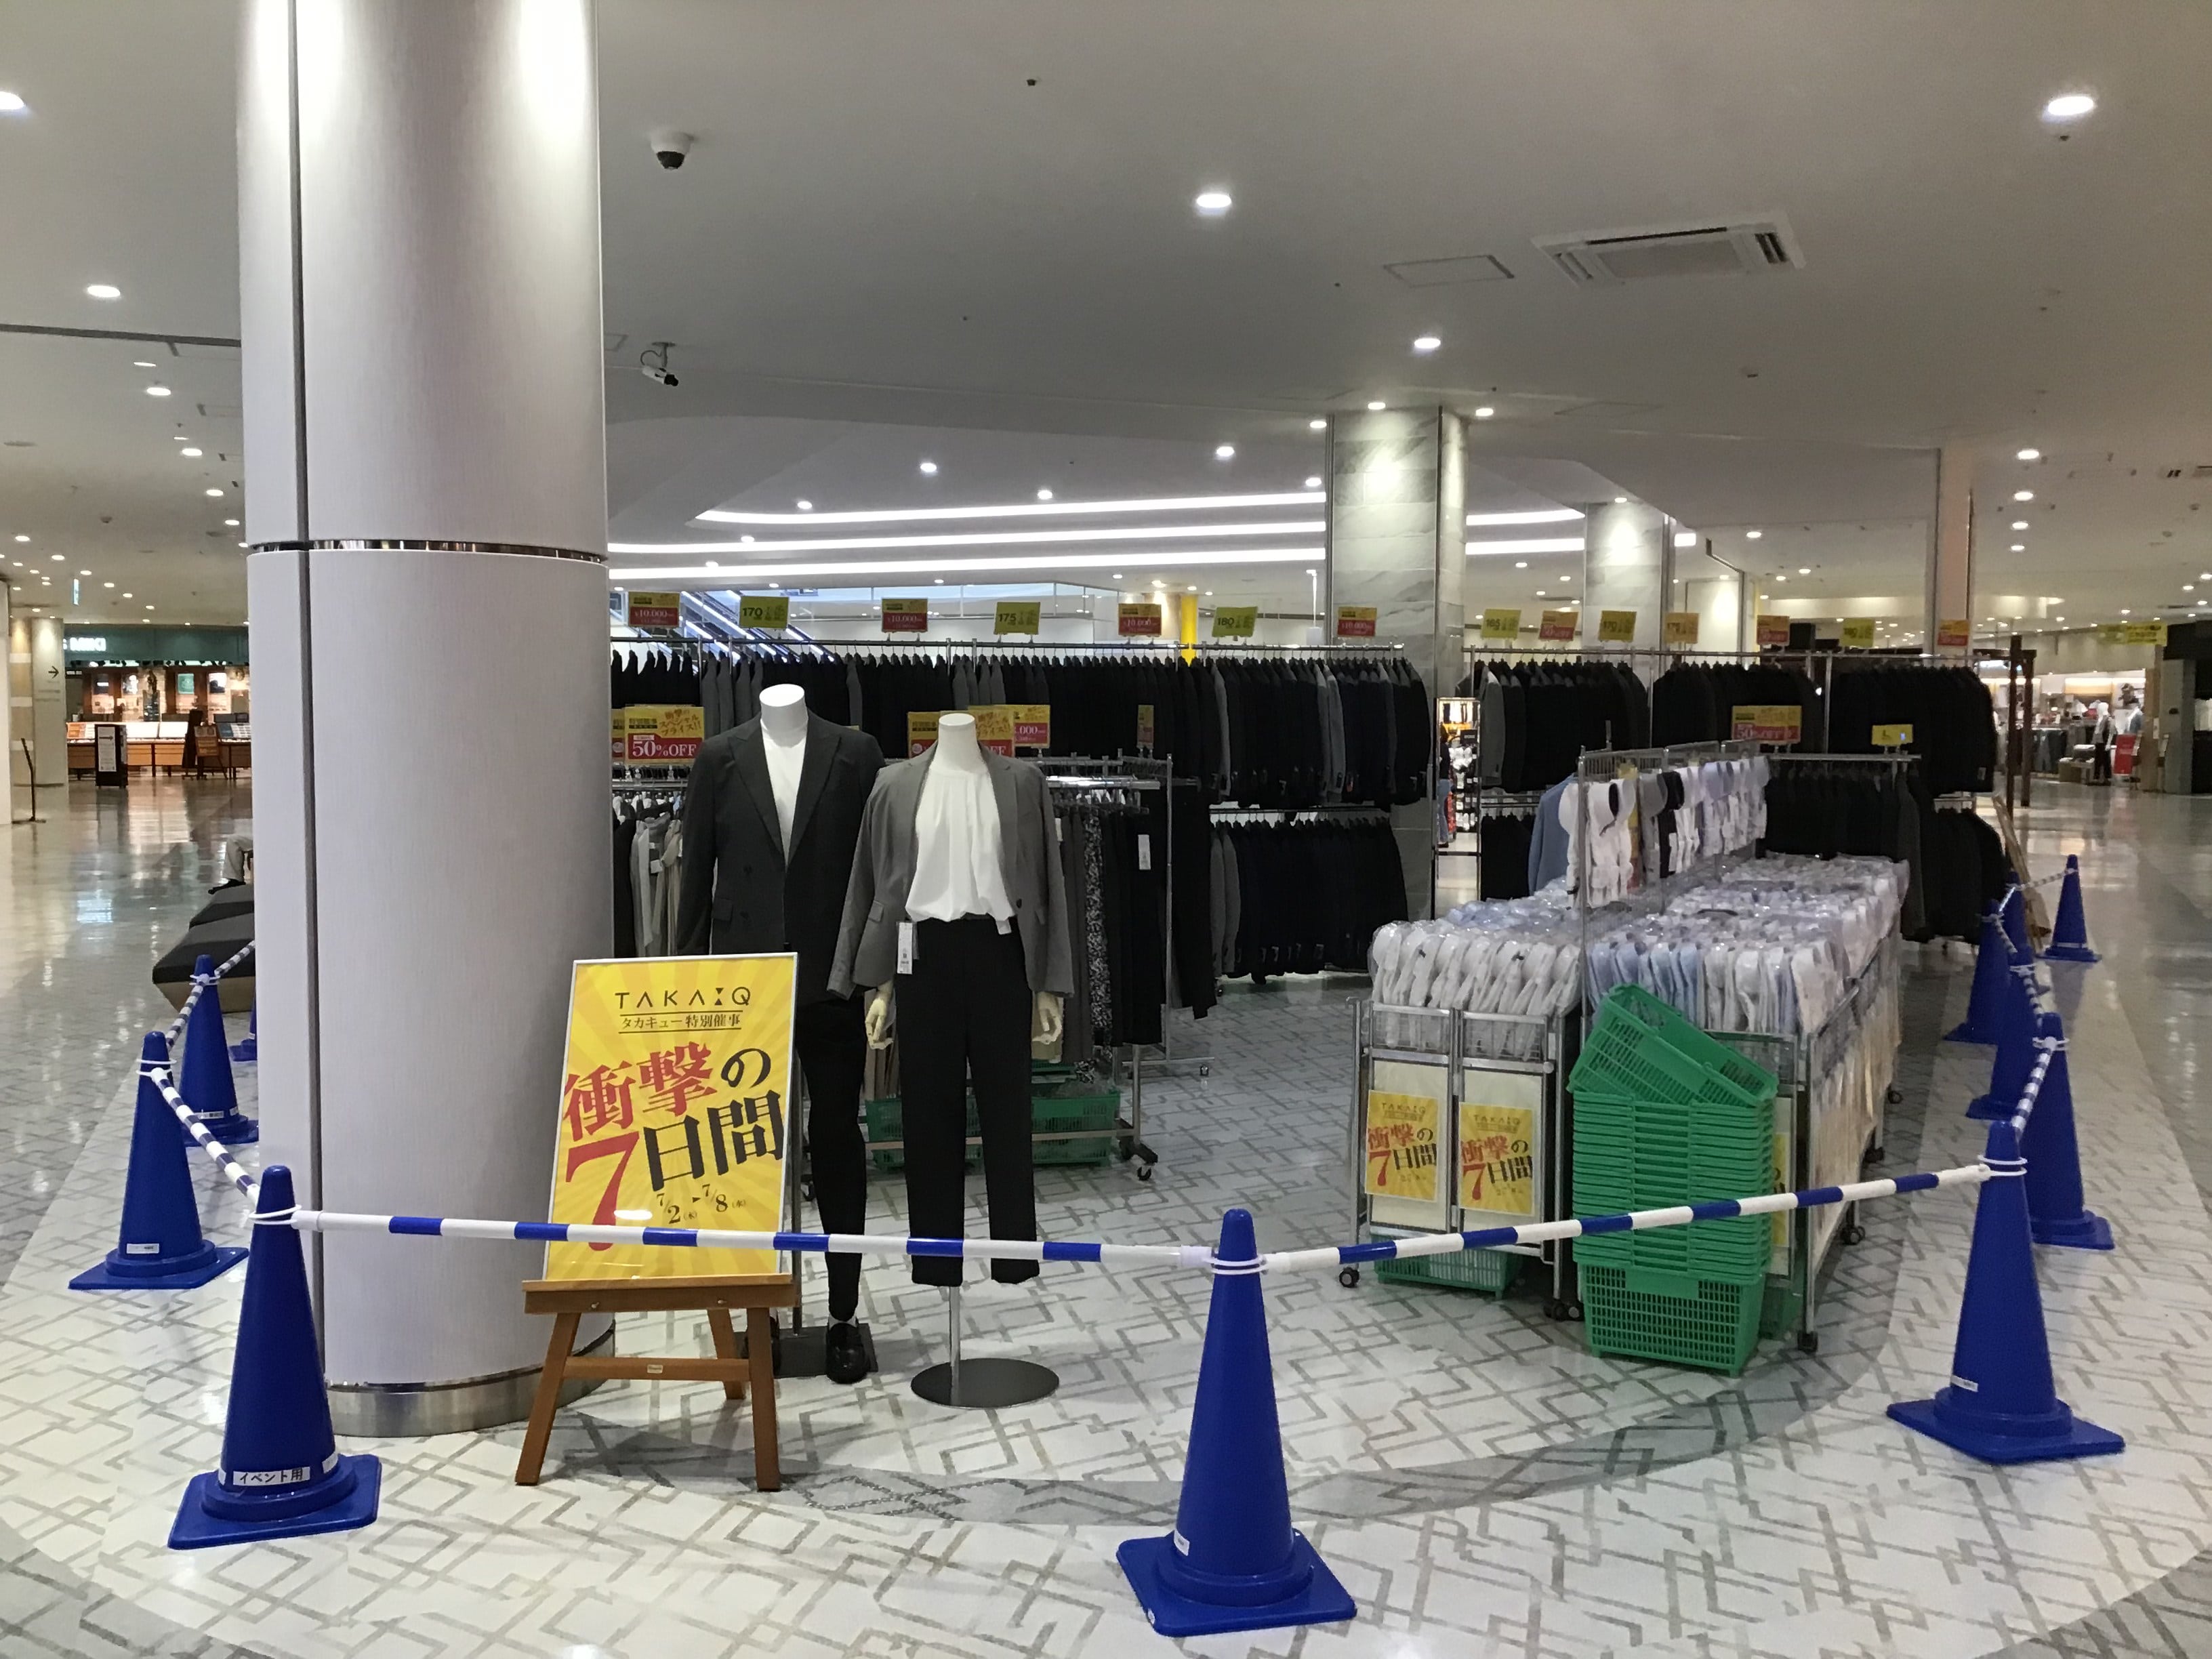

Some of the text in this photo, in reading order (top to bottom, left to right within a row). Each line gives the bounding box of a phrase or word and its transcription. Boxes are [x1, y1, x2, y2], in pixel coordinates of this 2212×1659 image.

[743, 607, 762, 617] 170
[999, 613, 1017, 621] 175
[632, 740, 697, 757] 50%OFF
[564, 1042, 771, 1142] 衝撃の
[240, 1468, 303, 1484] イベント用
